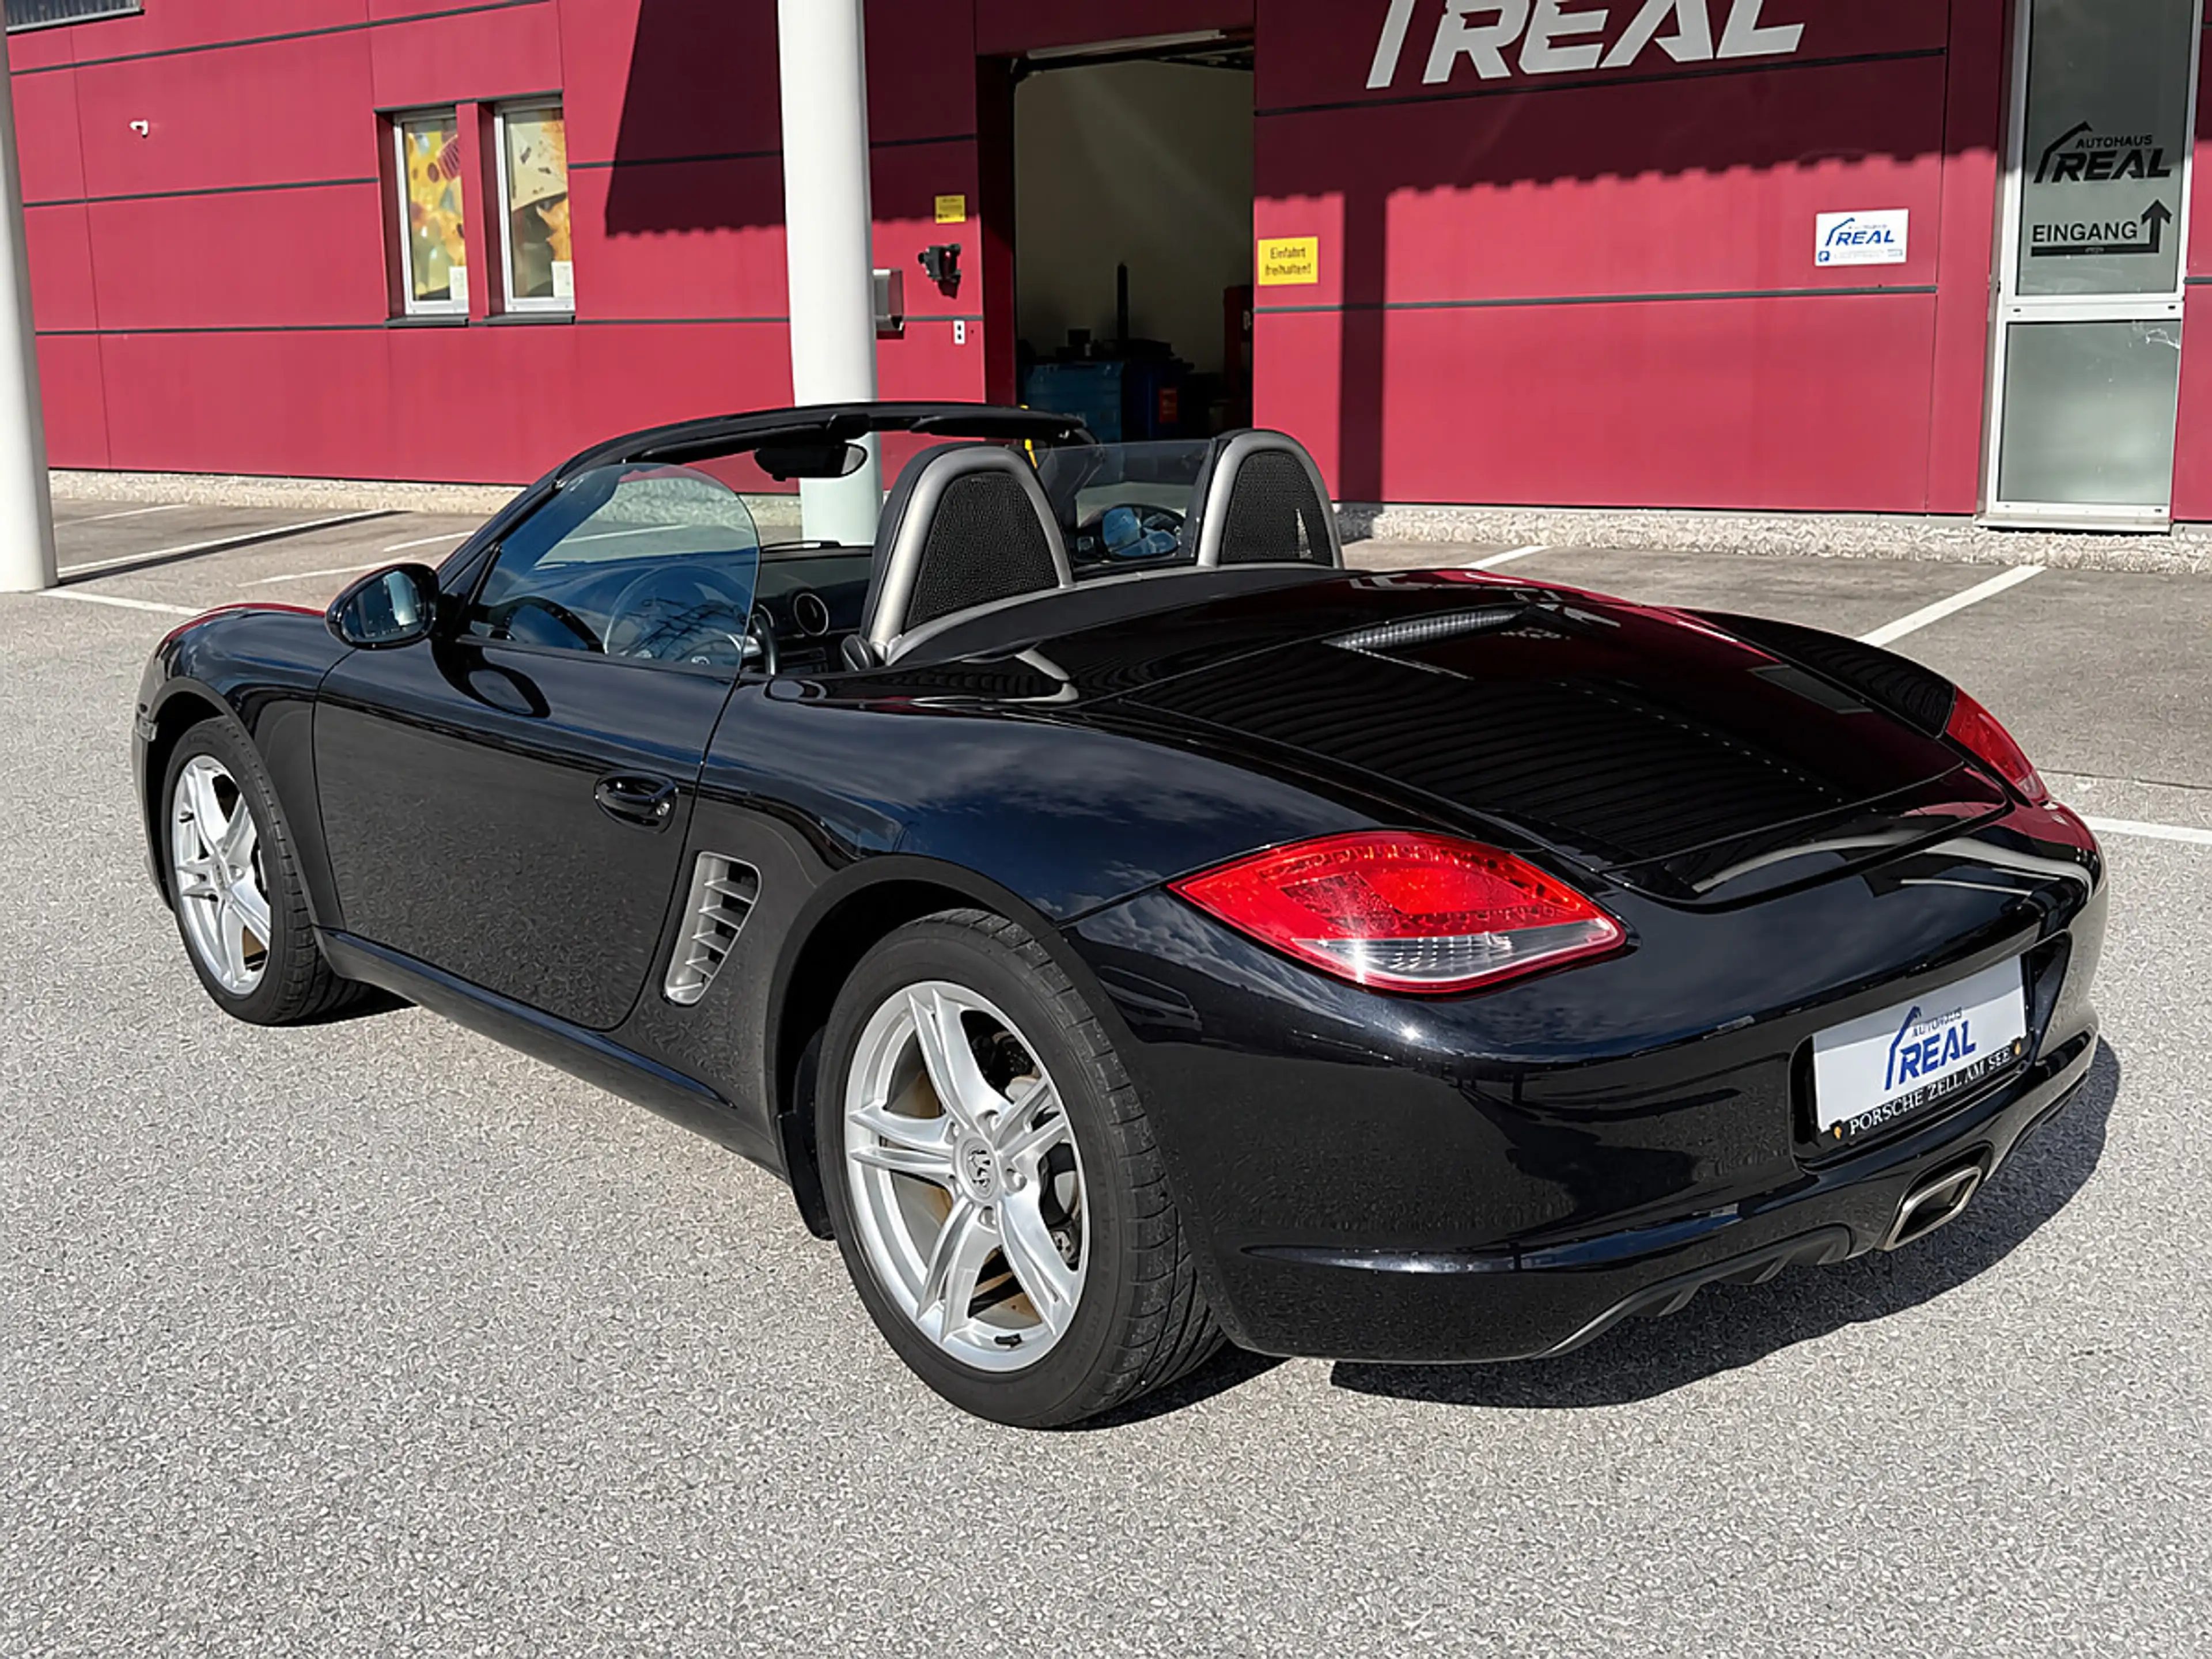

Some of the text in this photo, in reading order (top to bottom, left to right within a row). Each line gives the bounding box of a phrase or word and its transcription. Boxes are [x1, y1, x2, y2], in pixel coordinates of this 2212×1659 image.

[1422, 0, 1805, 84] REAL
[2075, 134, 2153, 149] AUTOHAUS
[2051, 147, 2172, 183] REAL
[1835, 229, 1895, 246] REAL
[2032, 221, 2138, 243] EINGANG
[1899, 1020, 1976, 1085] REAL
[1849, 1046, 2012, 1136] PORSCHE ZELL AM SEE
